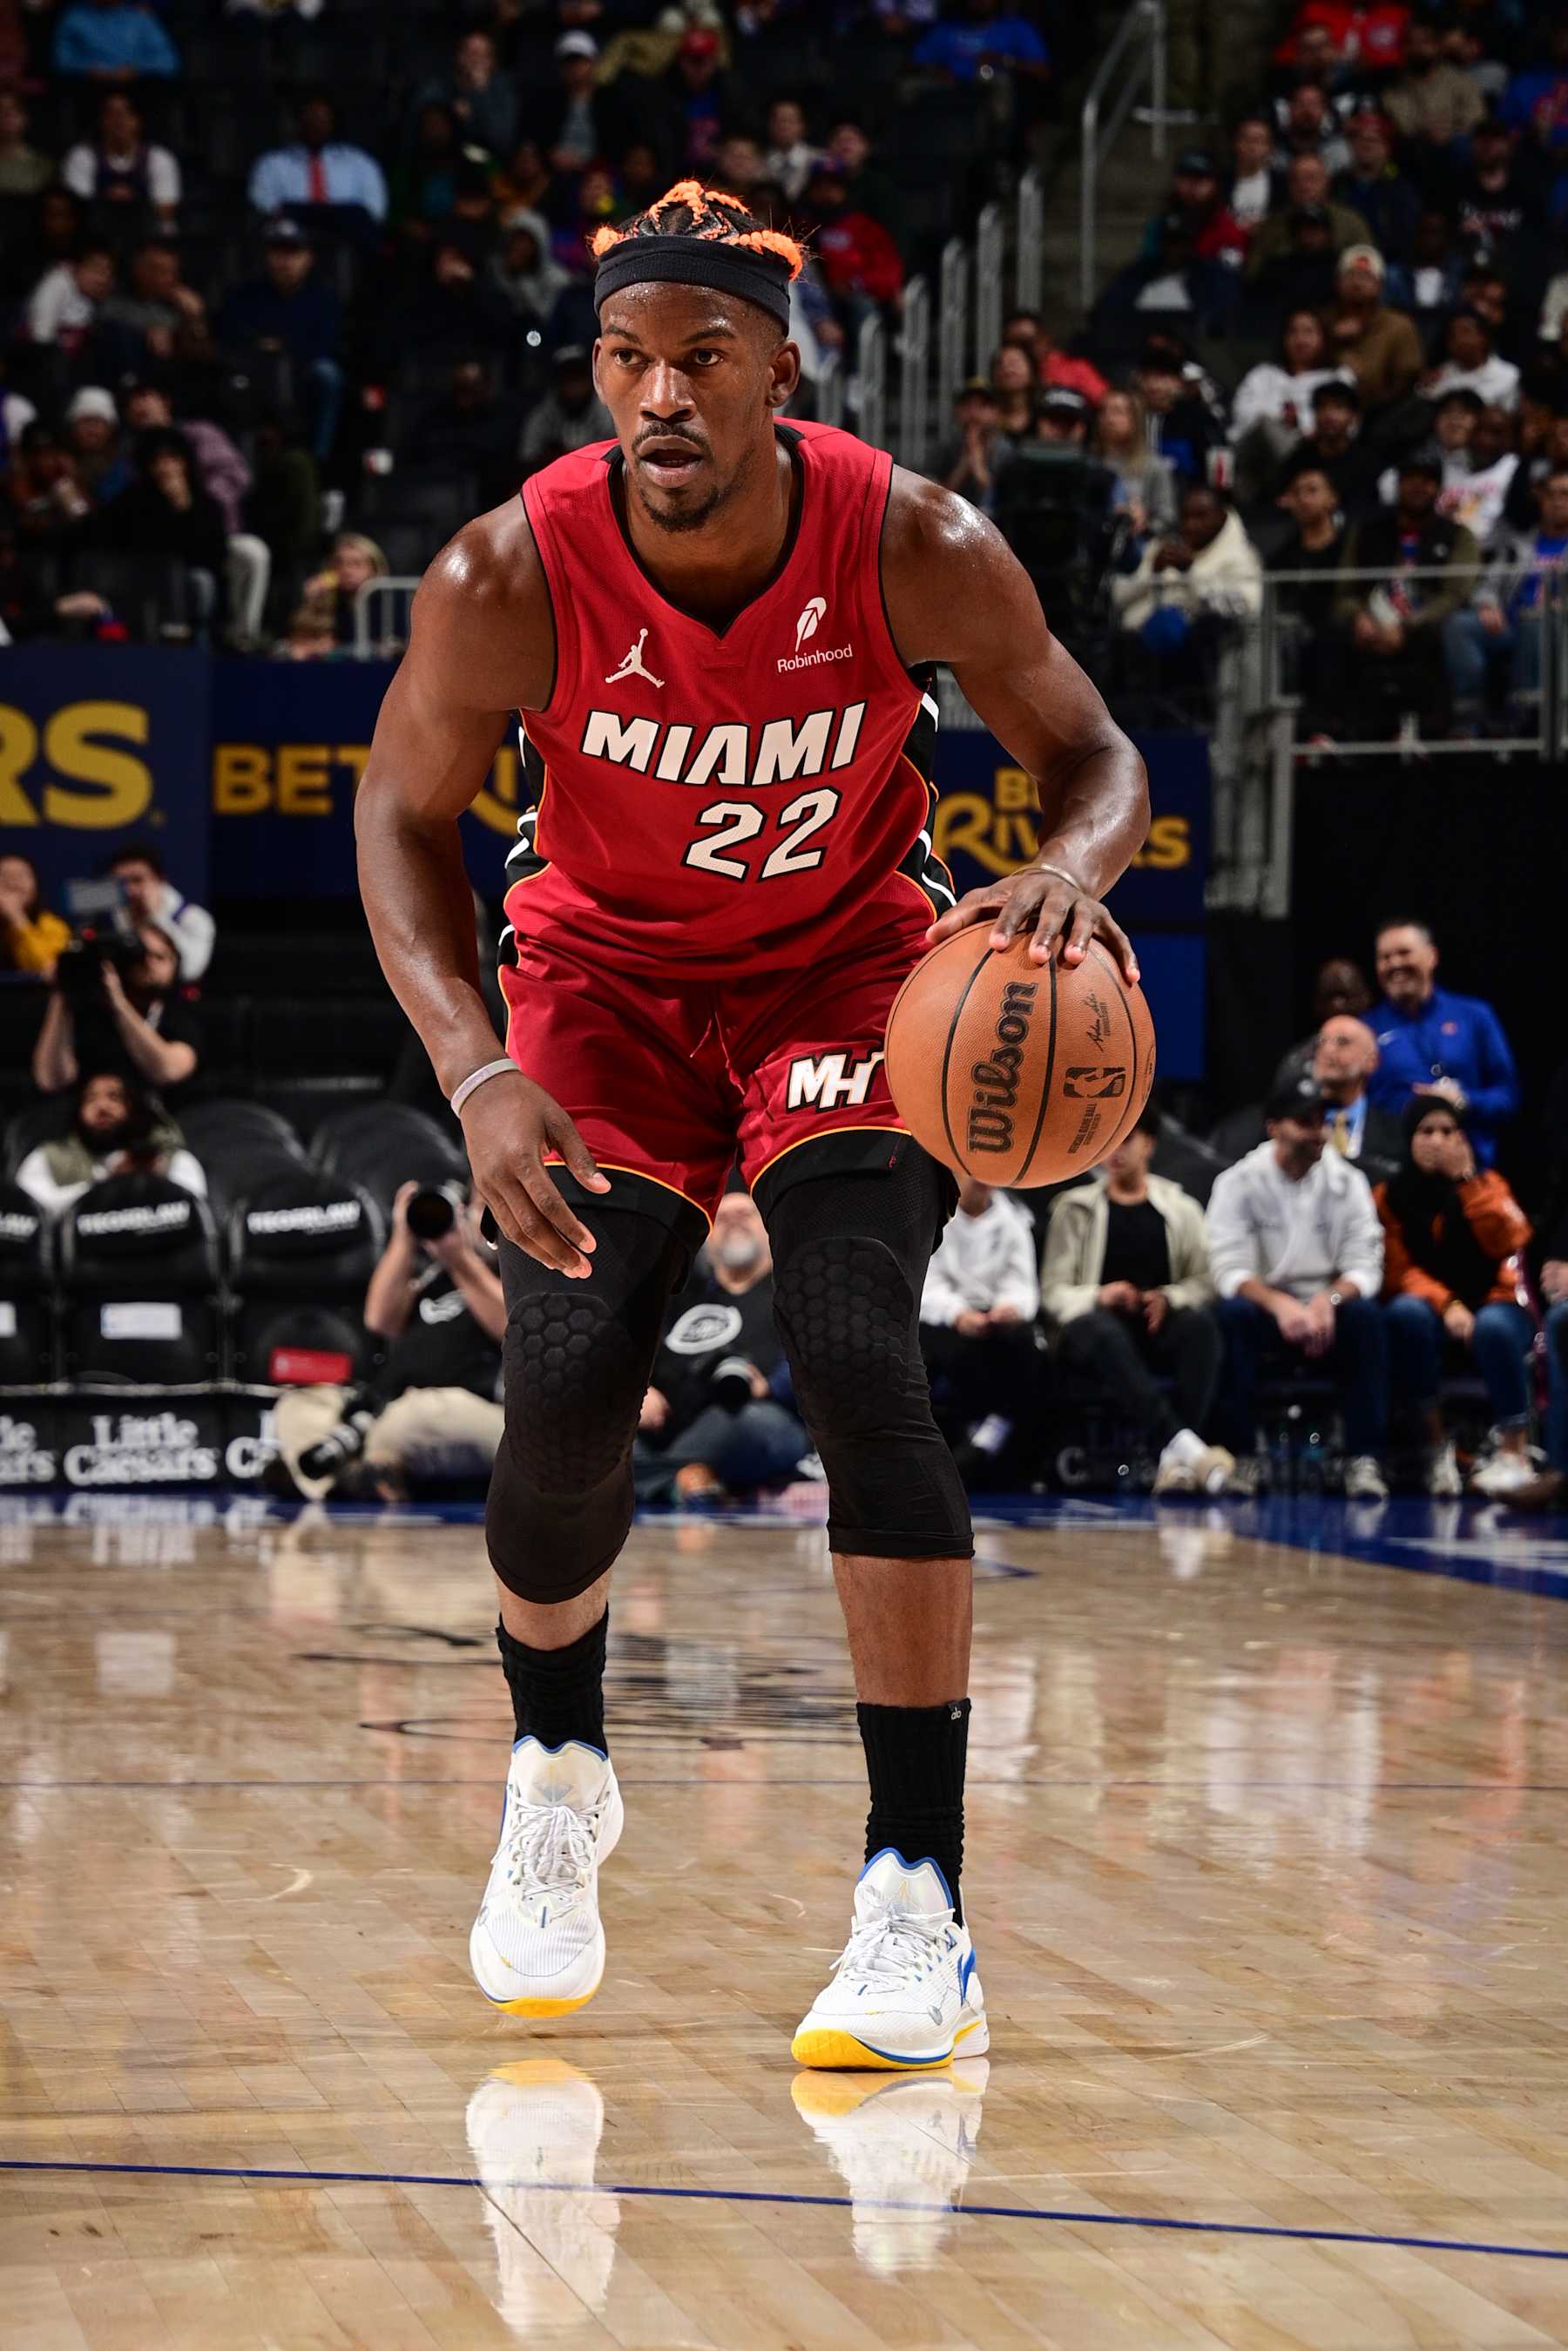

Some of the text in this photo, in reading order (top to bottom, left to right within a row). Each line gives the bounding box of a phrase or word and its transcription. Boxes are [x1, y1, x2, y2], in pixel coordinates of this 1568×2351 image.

[777, 643, 853, 673] Robinhood
[581, 701, 868, 786] MIAMI
[684, 787, 841, 881] 22
[967, 982, 1038, 1153] Wilson
